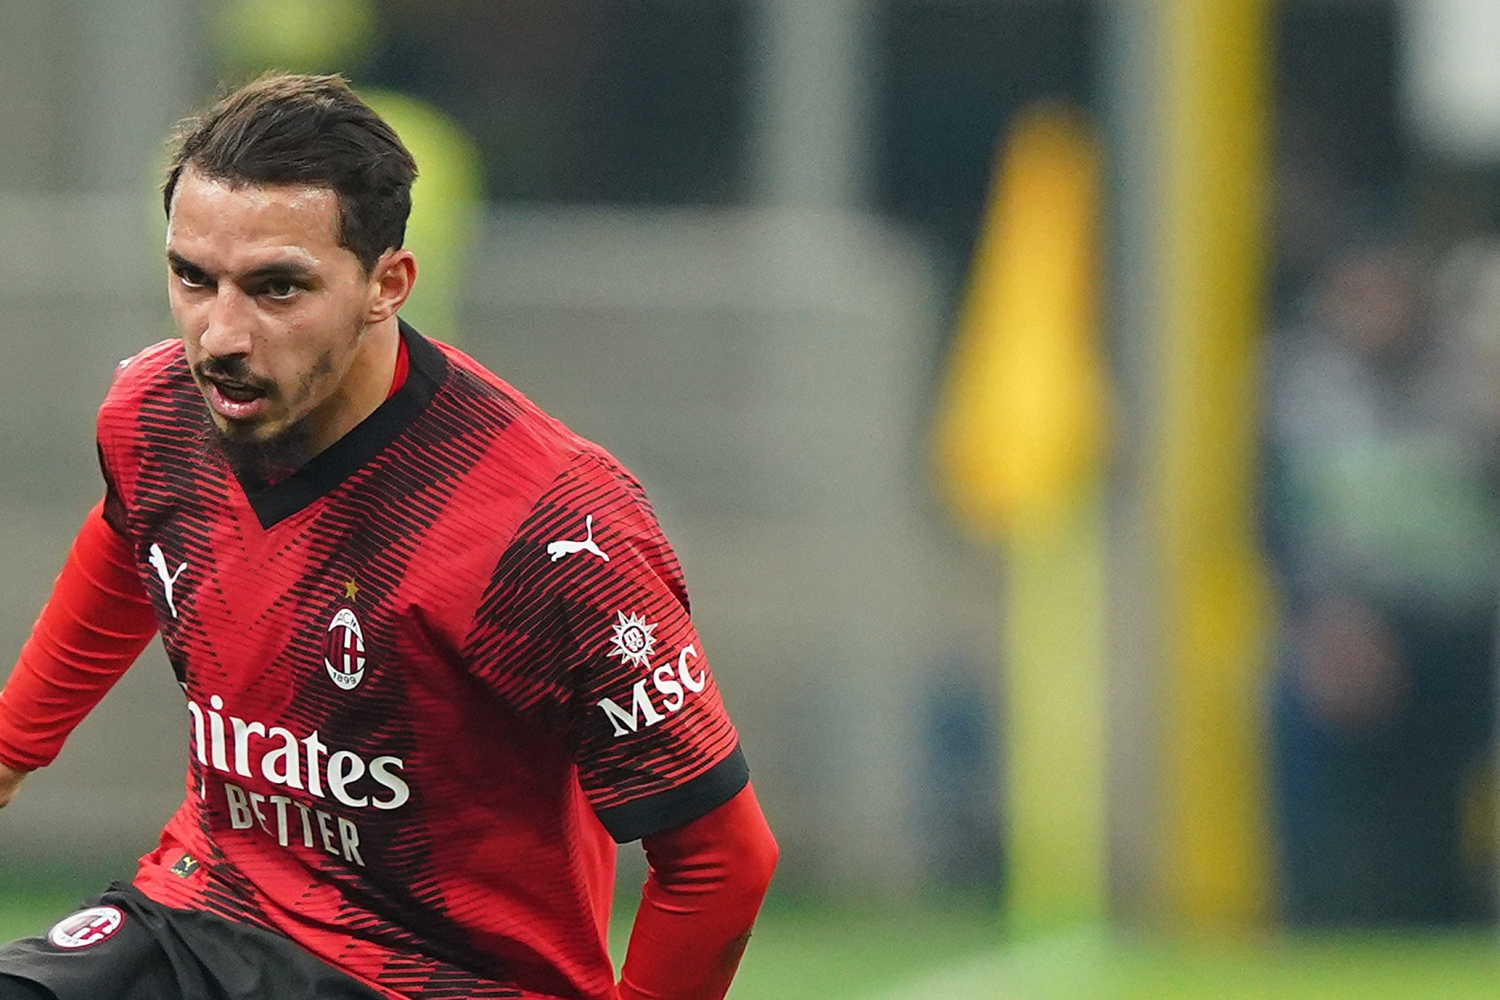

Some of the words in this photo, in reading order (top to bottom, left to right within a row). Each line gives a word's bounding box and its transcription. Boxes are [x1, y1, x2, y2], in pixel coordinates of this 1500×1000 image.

[332, 671, 358, 685] 1899
[596, 643, 706, 738] MSC
[224, 782, 366, 868] BETTER
